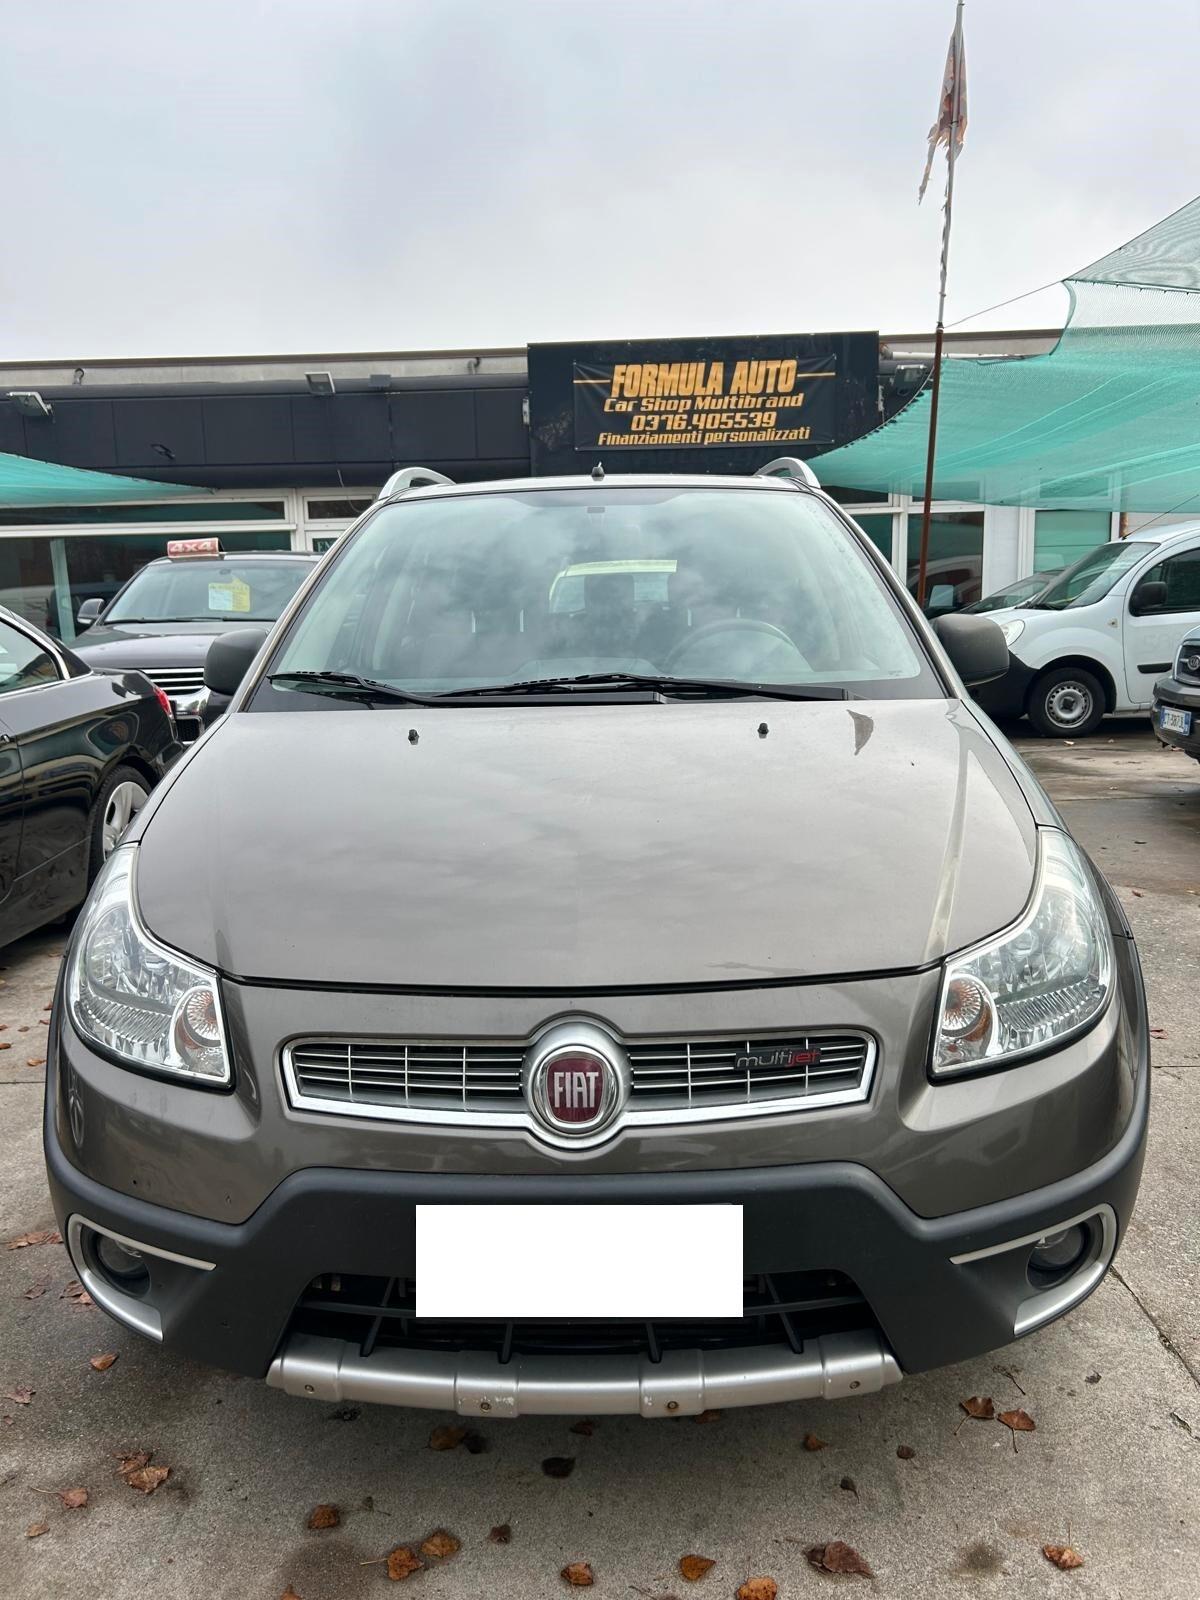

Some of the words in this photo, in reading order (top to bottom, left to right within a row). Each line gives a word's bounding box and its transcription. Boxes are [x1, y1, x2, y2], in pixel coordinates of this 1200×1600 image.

[611, 361, 724, 398] FORMULA
[729, 359, 798, 395] AUTO
[603, 398, 638, 412] Car
[640, 397, 692, 413] Shop
[694, 392, 805, 410] Multibrand
[630, 411, 777, 431] 0376.405539
[597, 430, 702, 446] Finanziamenti
[703, 426, 811, 446] personalizzati
[736, 1049, 822, 1068] multijet
[553, 1071, 600, 1109] FIAT
